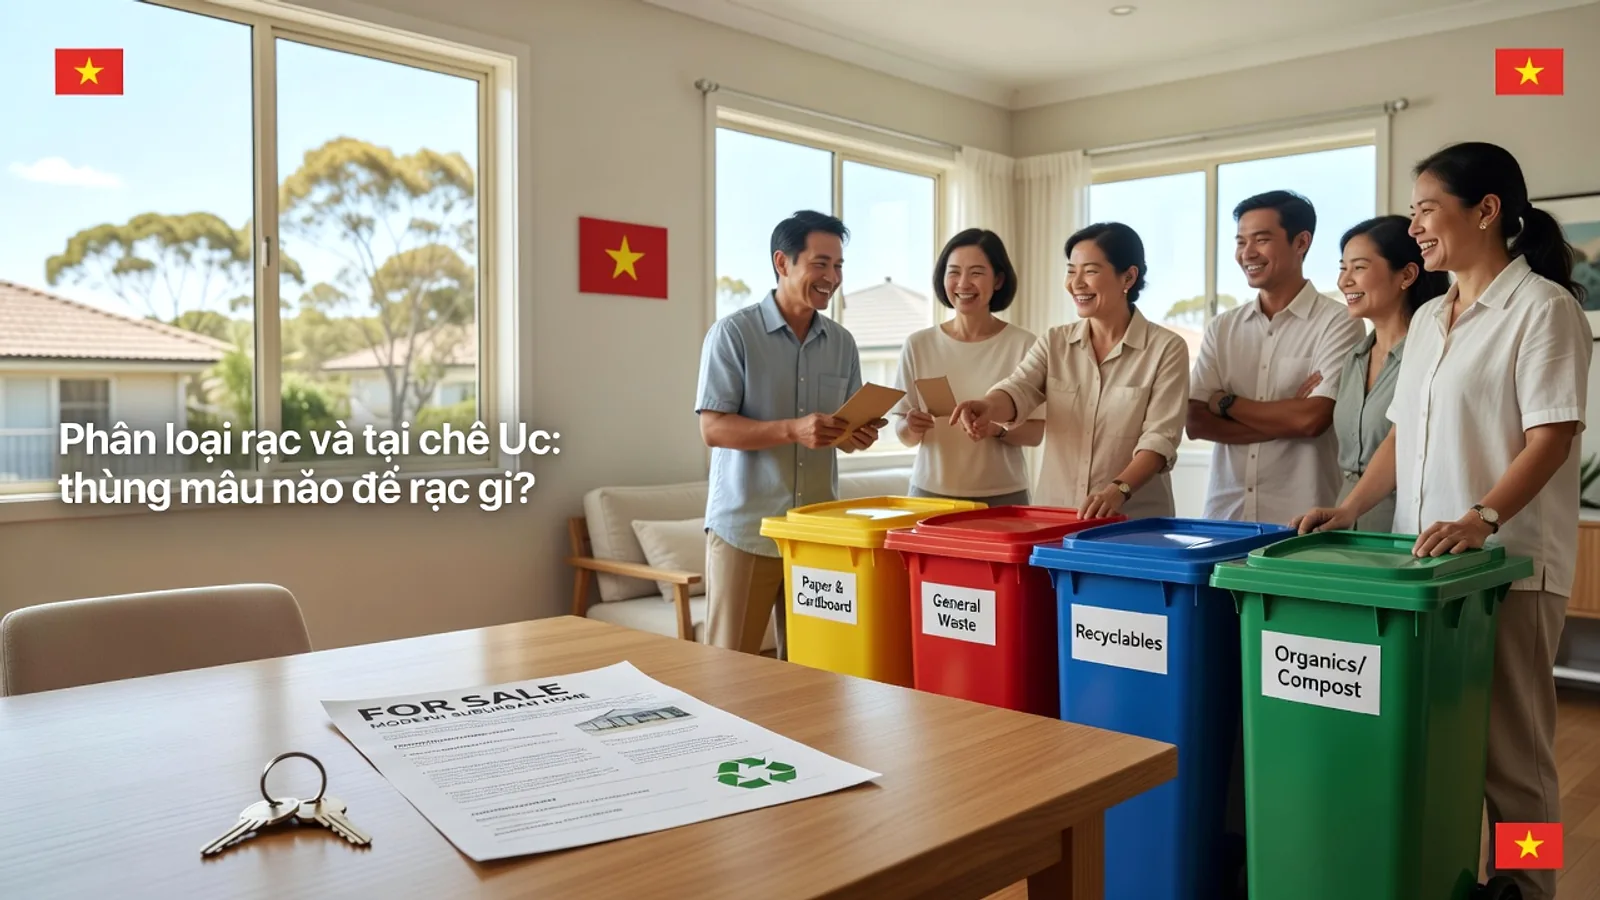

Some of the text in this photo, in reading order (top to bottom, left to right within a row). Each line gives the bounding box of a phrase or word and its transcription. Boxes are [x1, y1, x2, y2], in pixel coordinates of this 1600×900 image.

[802, 575, 844, 594] Paper &
[933, 593, 980, 613] General
[937, 612, 977, 632] Waste
[1076, 623, 1163, 651] Recyclables
[1275, 645, 1367, 675] Organics/
[1278, 668, 1362, 698] Compost
[357, 699, 456, 721] FOR
[461, 682, 569, 708] SALE
